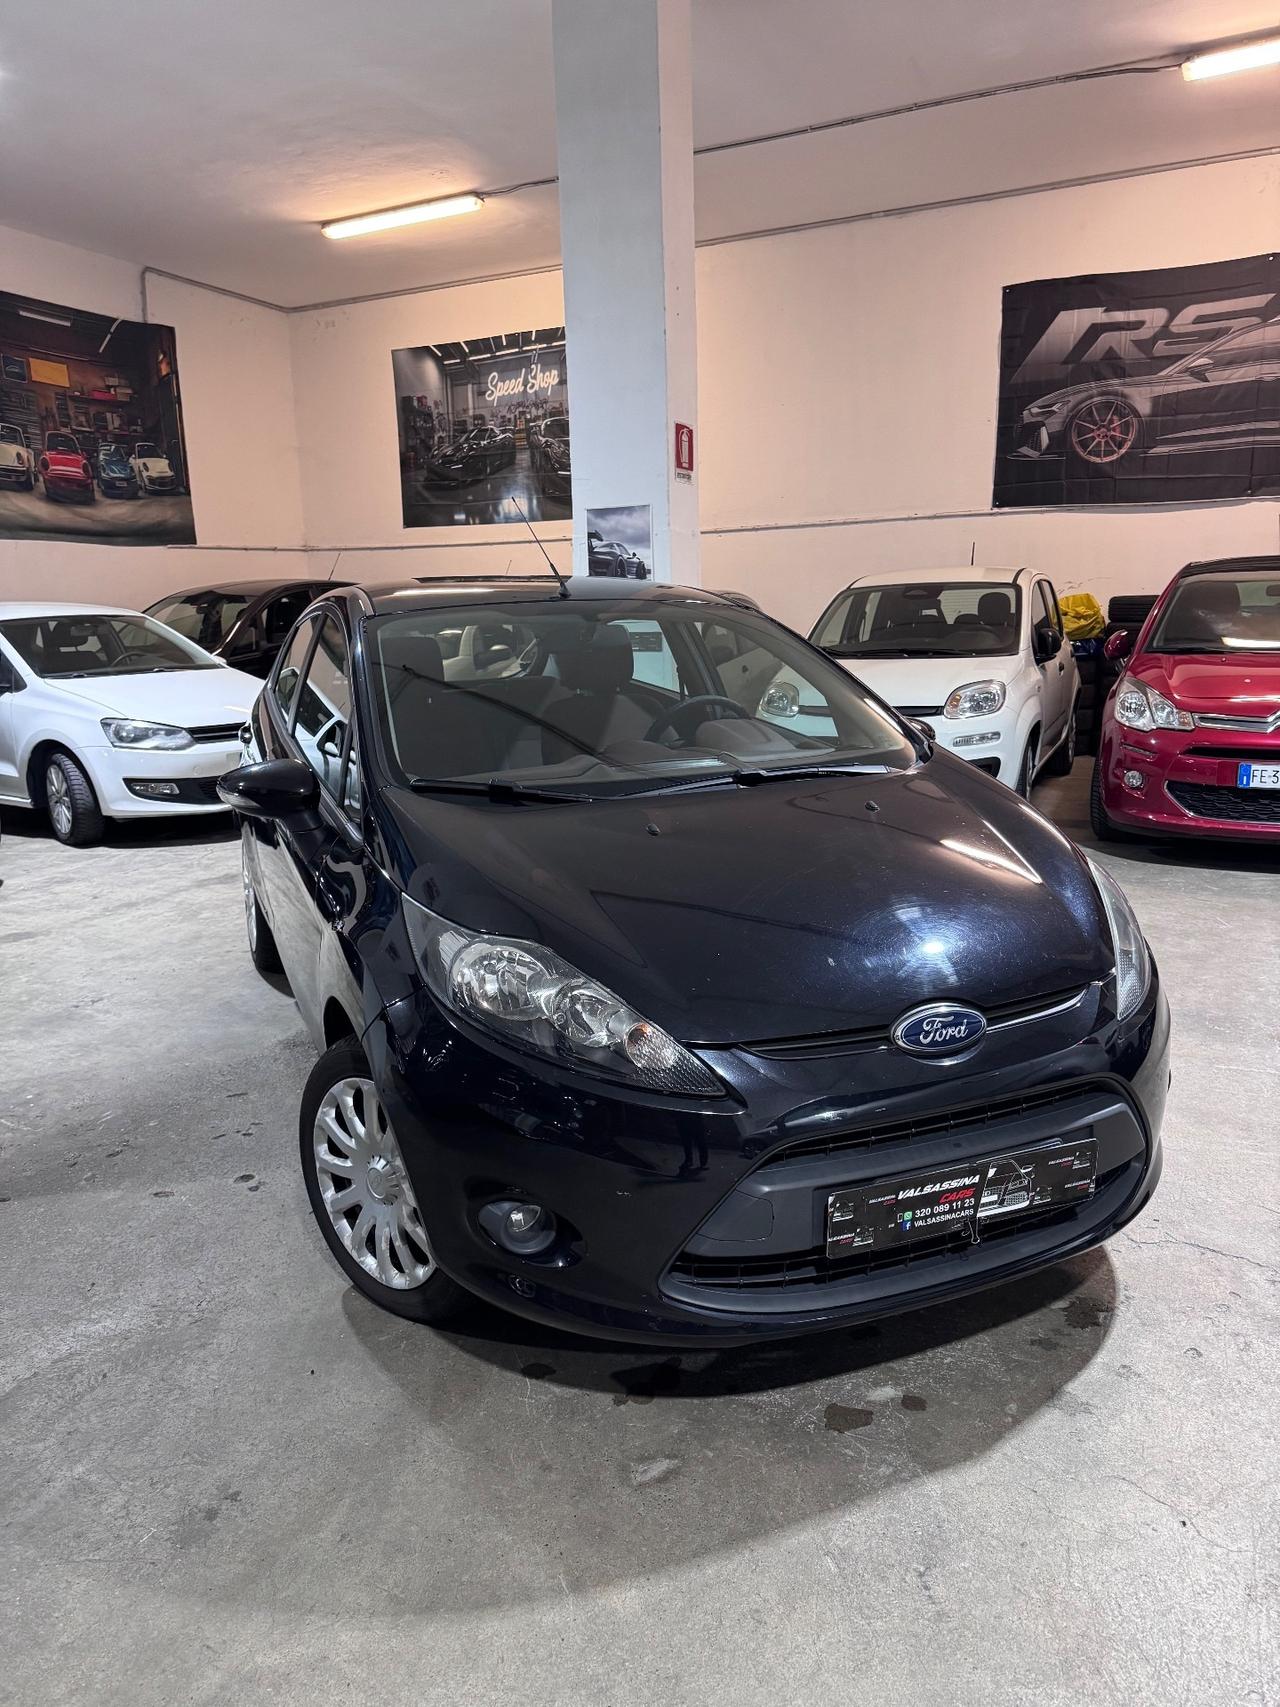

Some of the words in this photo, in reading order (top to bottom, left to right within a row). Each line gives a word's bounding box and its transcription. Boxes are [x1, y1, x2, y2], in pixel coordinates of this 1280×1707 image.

[1012, 293, 1277, 382] RS
[485, 368, 525, 407] Speed
[527, 363, 559, 396] Shop
[919, 1016, 969, 1044] Ford
[897, 1174, 980, 1200] VALSASSINA
[939, 1187, 976, 1203] CARS
[914, 1208, 974, 1228] VALSASSINACARS
[915, 1207, 931, 1218] 320
[933, 1203, 950, 1213] 089
[952, 1200, 961, 1210] 11
[964, 1198, 975, 1207] 23
